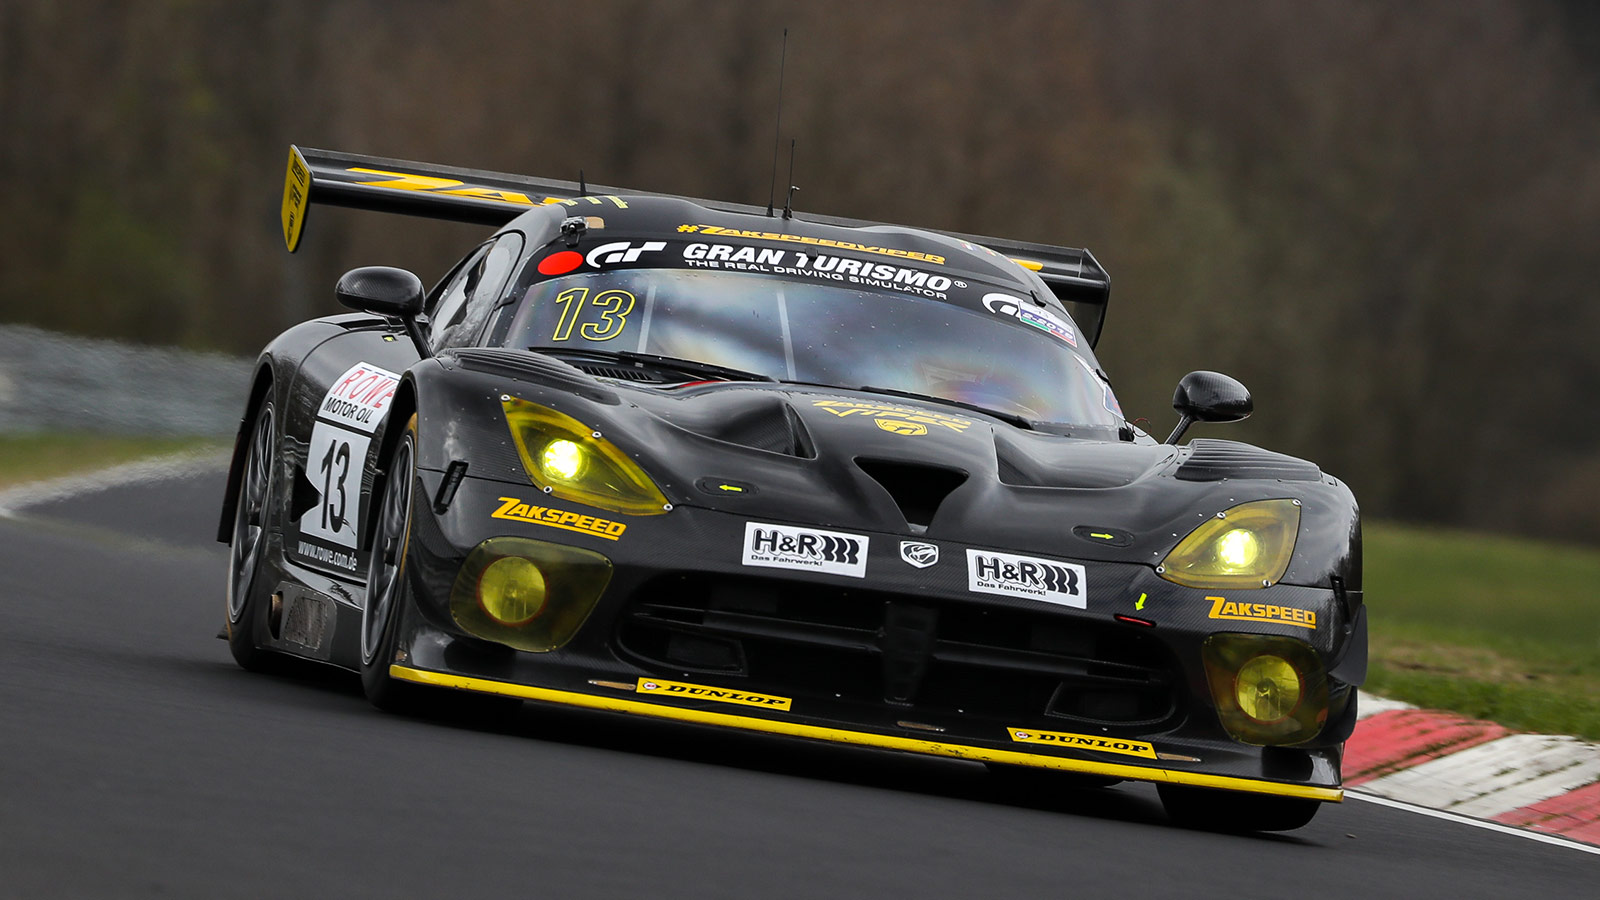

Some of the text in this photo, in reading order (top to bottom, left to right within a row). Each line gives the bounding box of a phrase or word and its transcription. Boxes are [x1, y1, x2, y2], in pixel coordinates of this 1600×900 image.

[683, 243, 785, 266] GRAN
[685, 259, 947, 300] THE REAL DRIVING SIMULATOR
[552, 287, 636, 341] 13
[334, 370, 396, 408] ROWE
[323, 397, 374, 424] MOTOR OIL
[321, 439, 350, 533] 13
[491, 496, 627, 541] ZAKSPEED
[298, 541, 358, 571] www.rowe.com.de
[753, 528, 823, 559] H&R
[751, 554, 823, 566] Das Fahrwerk!
[975, 555, 1044, 588] H&R
[977, 580, 1046, 596] Das Fahrwerk!
[1205, 596, 1316, 629] ZAKSPEED
[665, 685, 786, 706] DUNLOP
[1039, 734, 1148, 752] DUNLOP
